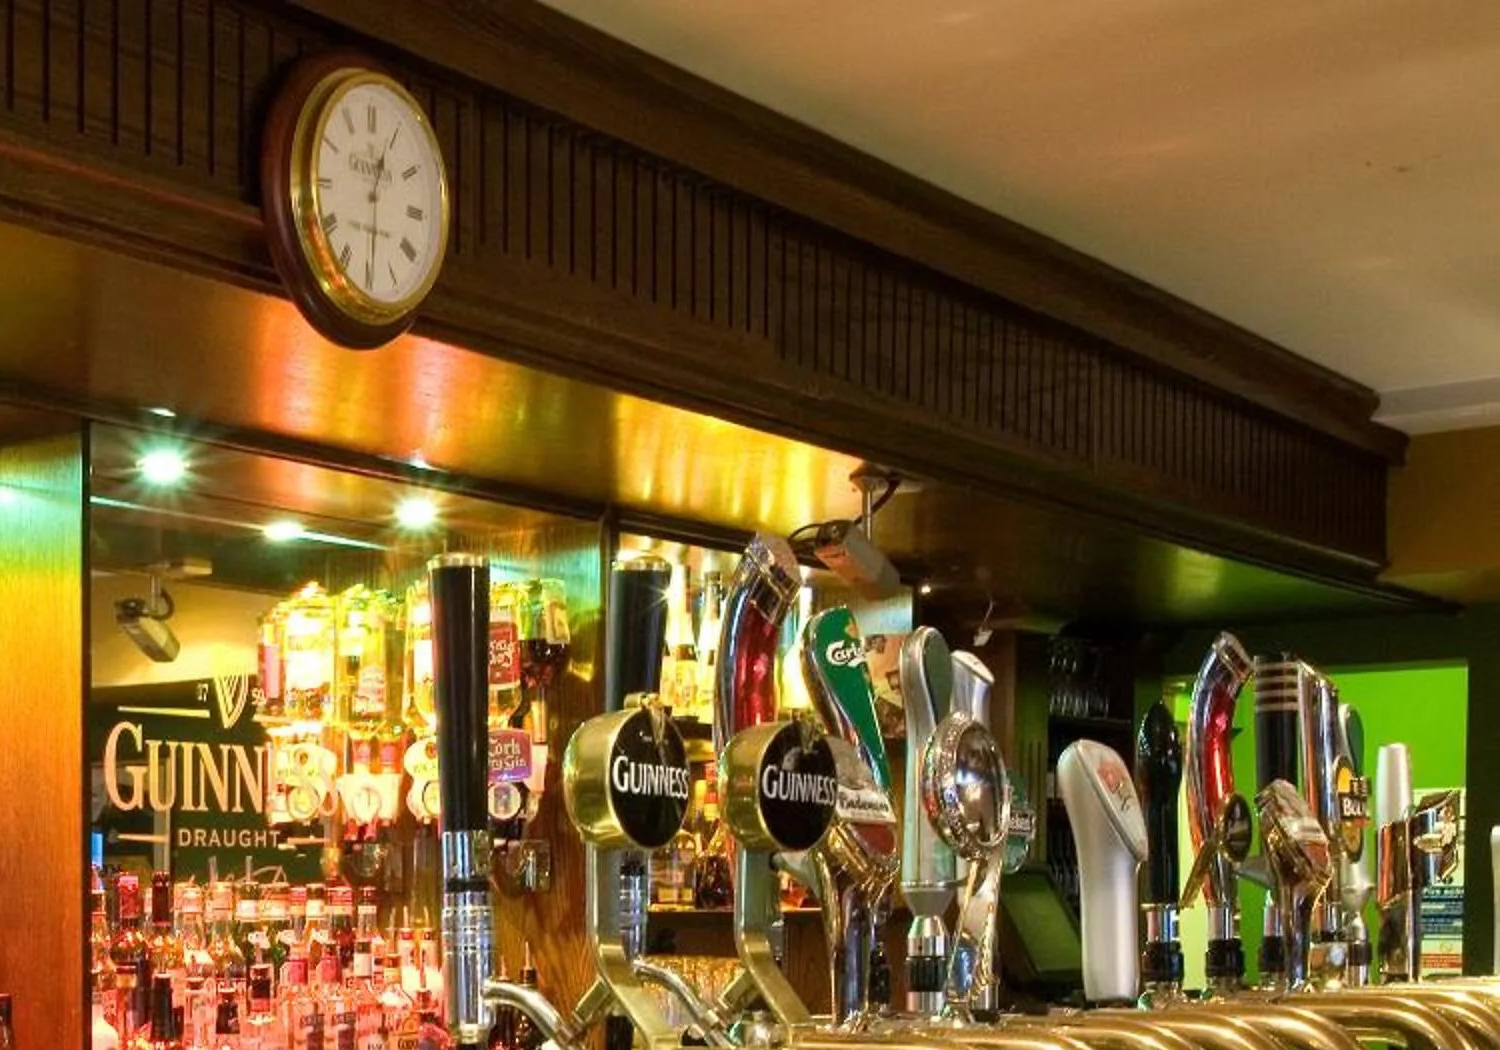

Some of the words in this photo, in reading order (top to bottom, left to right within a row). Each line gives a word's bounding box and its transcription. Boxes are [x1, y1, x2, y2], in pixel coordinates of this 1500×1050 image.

[103, 721, 273, 815] GUINN
[612, 754, 690, 800] GUINNESS
[761, 763, 837, 806] GUINNESS
[177, 828, 281, 849] DRAUGHT
